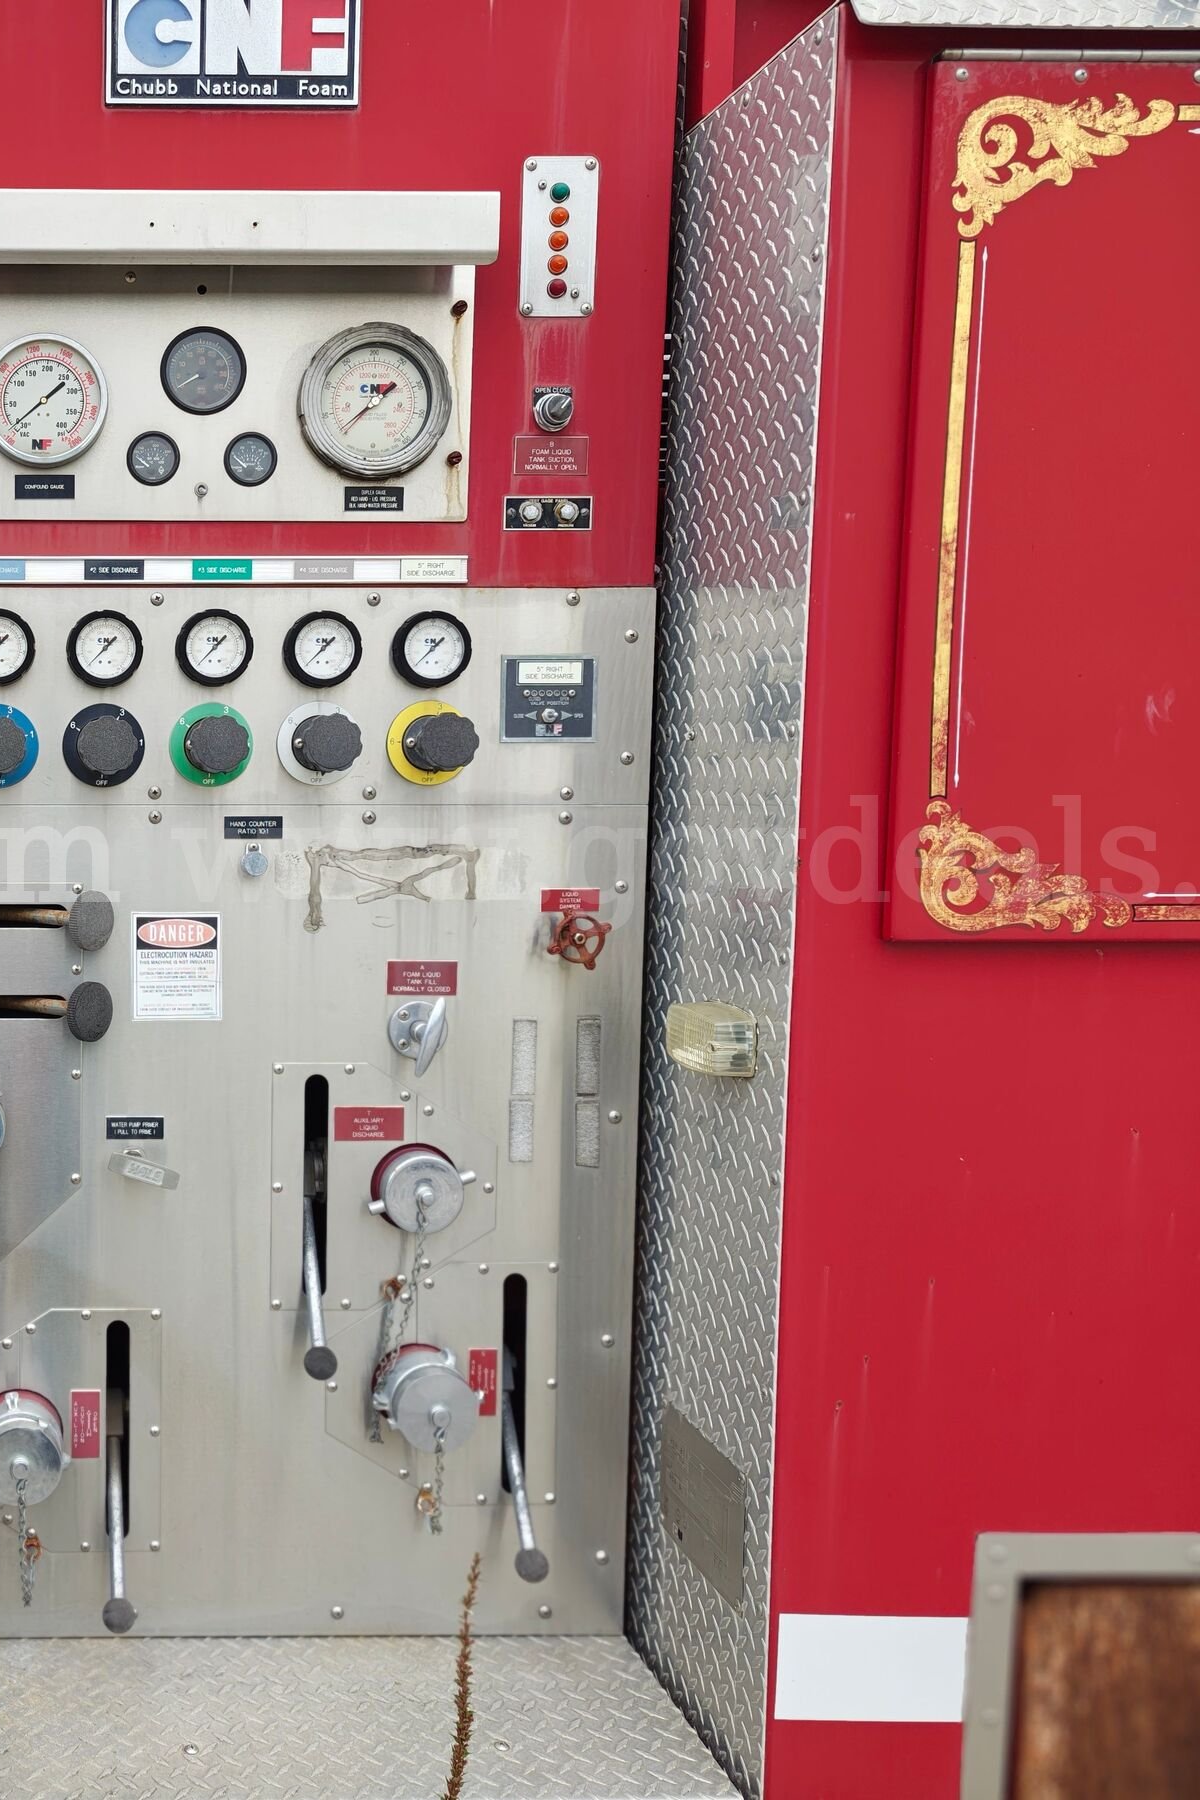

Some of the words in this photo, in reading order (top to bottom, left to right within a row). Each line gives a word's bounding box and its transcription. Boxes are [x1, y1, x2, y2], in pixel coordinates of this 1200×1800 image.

[117, 79, 178, 96] Chubb
[196, 79, 278, 96] National
[299, 80, 348, 96] Foam
[149, 925, 204, 942] DANGER
